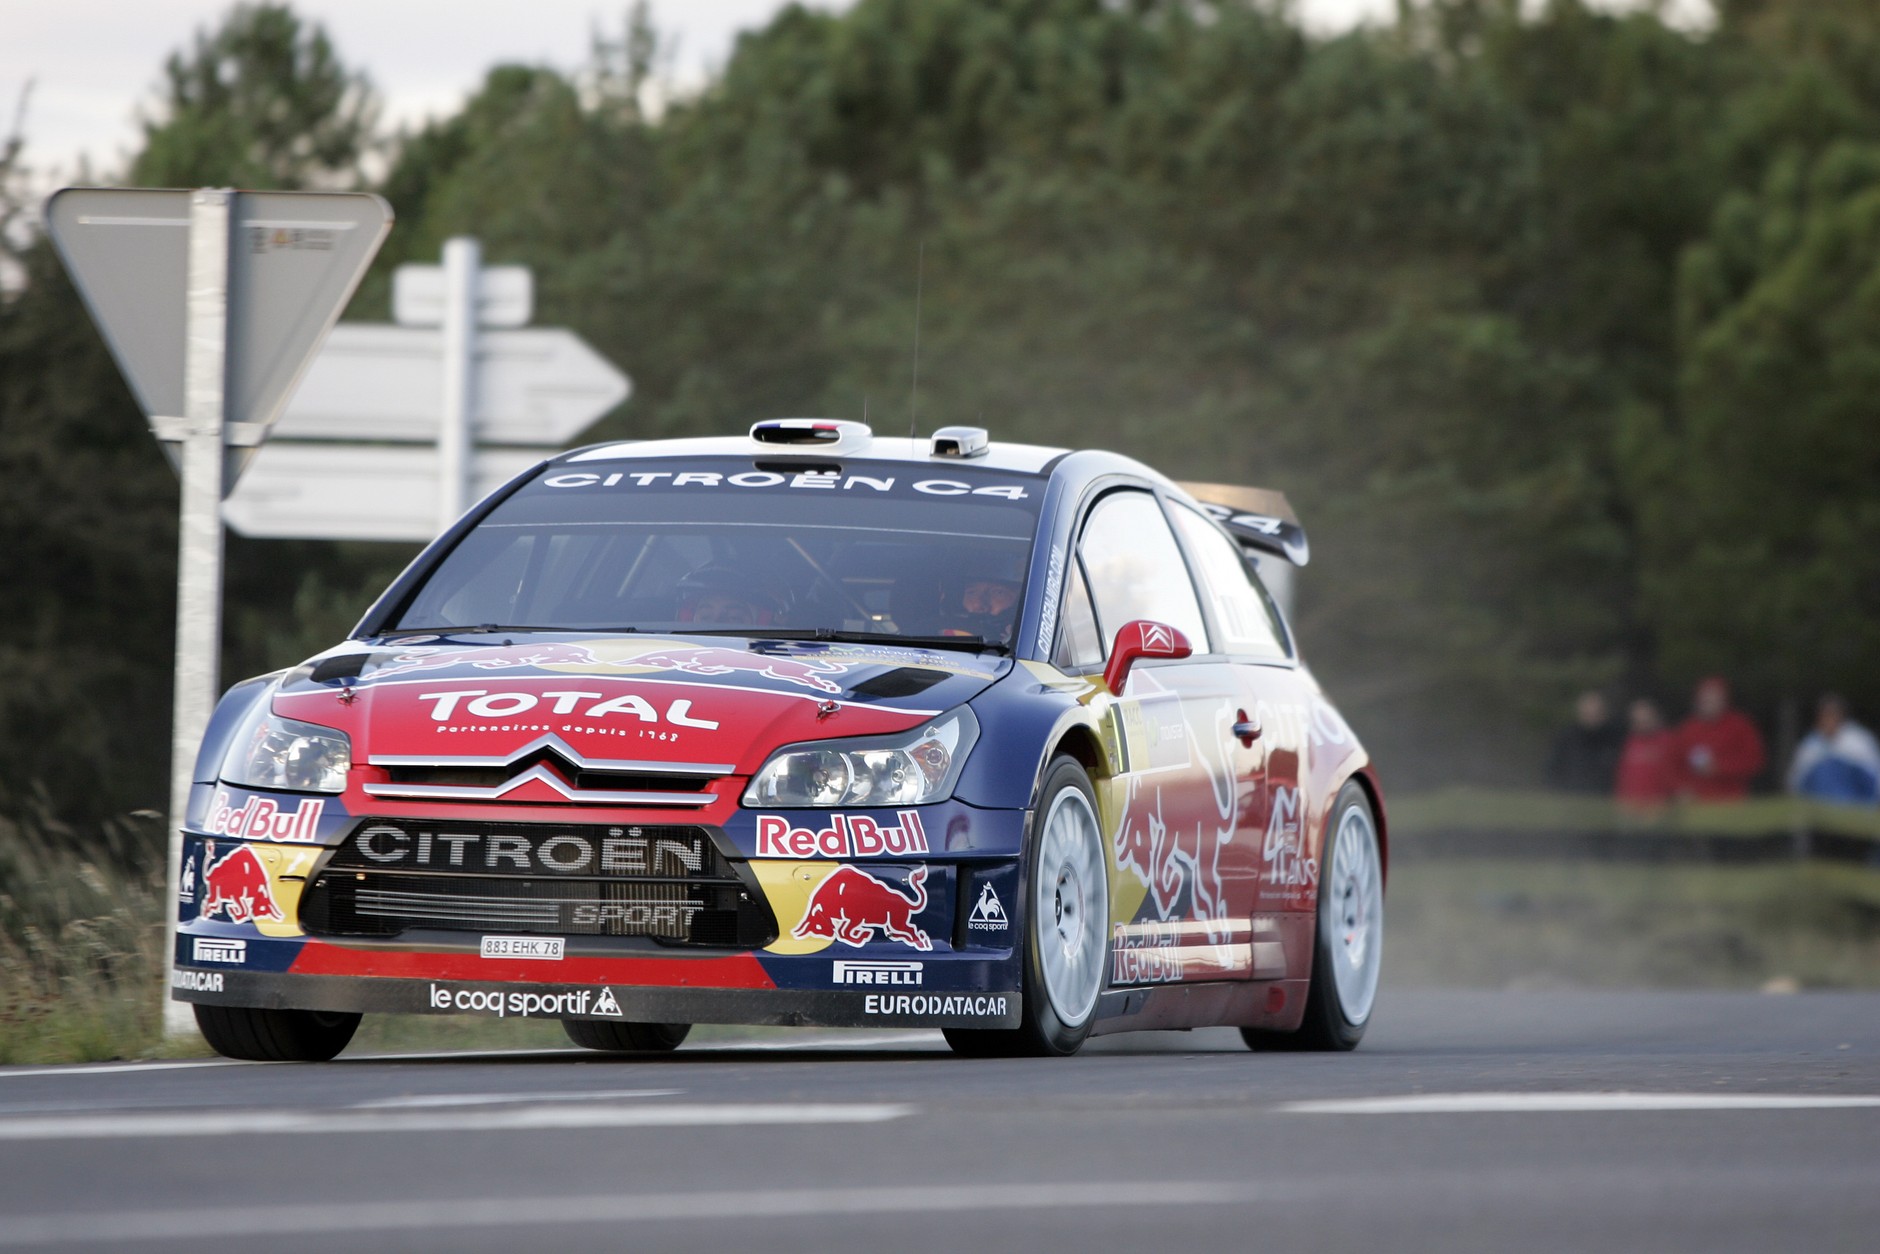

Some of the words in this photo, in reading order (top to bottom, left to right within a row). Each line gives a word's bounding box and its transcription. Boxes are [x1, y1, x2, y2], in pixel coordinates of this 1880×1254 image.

[543, 471, 895, 493] CITROËN
[911, 479, 1029, 500] C4
[418, 690, 719, 730] TOTAL
[437, 725, 550, 734] Partenaires
[562, 724, 627, 737] depuis
[639, 730, 679, 743] 1968
[243, 798, 325, 842] Bull
[756, 814, 850, 858] Red
[847, 810, 930, 856] Bull
[355, 826, 702, 871] CITROËN
[572, 905, 703, 925] SPORT
[974, 923, 988, 932] coq
[193, 938, 247, 963] PIRELLI
[486, 941, 508, 953] 883
[512, 941, 539, 954] EHK
[543, 942, 559, 955] 78
[833, 960, 924, 984] PIRELLI
[430, 983, 451, 1008] le
[455, 990, 504, 1017] coq
[508, 990, 591, 1017] sportif
[864, 995, 1007, 1015] EURODATACAR
